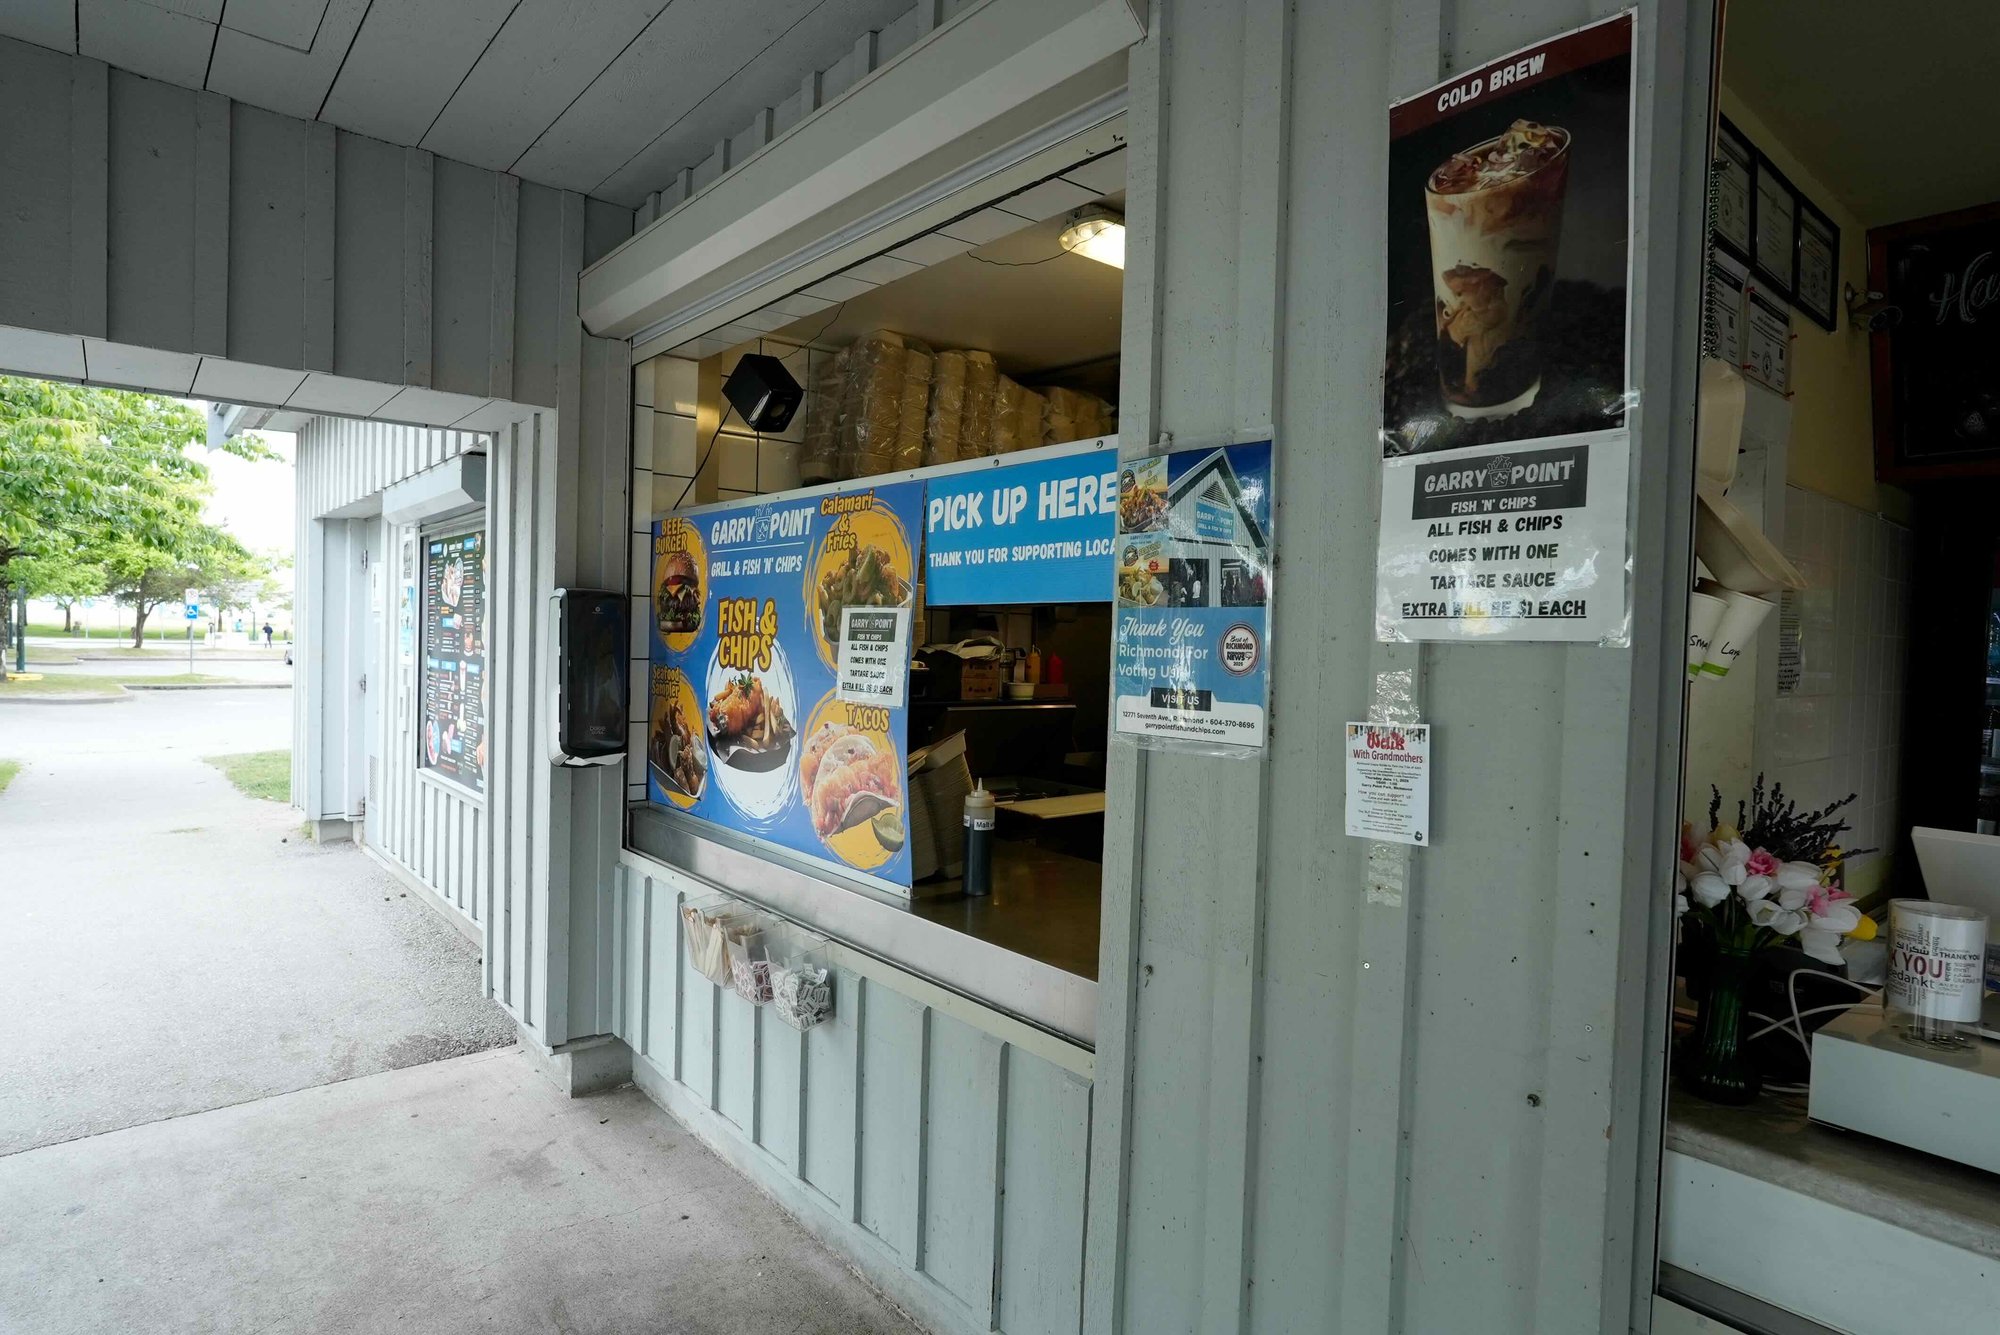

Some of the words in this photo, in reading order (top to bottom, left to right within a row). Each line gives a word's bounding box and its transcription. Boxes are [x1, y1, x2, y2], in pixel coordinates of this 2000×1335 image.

[1438, 78, 1483, 112] COLD
[1490, 53, 1546, 92] BREW
[1424, 469, 1488, 493] GARRY
[1511, 460, 1575, 485] POINT
[820, 488, 874, 516] Calamari
[928, 492, 984, 533] PICK
[992, 486, 1028, 526] UP
[1038, 472, 1118, 521] HERE
[1451, 501, 1477, 514] FISH
[1482, 499, 1495, 511] 'N'
[1499, 496, 1537, 510] CHIPS
[662, 518, 683, 536] BEEF
[711, 516, 756, 546] GARRY
[769, 507, 816, 540] POINT
[838, 513, 850, 533] &
[1428, 523, 1453, 537] ALL
[1459, 520, 1491, 535] FISH
[1497, 519, 1508, 532] &
[1515, 515, 1563, 532] CHIPS
[656, 532, 688, 555] BURGER
[826, 531, 856, 553] Fries
[930, 551, 962, 568] THANK
[964, 549, 984, 564] YOU
[988, 548, 1008, 563] FOR
[1012, 540, 1082, 562] SUPPORTING
[1429, 548, 1477, 563] COMES
[1482, 545, 1520, 560] WITH
[1526, 543, 1559, 559] ONE
[711, 562, 732, 578] GRILL
[734, 562, 740, 576] &
[742, 559, 760, 576] FISH
[764, 558, 774, 574] 'N'
[776, 555, 802, 572] CHIPS
[1431, 574, 1496, 590] TARTARE
[1502, 572, 1556, 588] SAUCE
[718, 597, 758, 636] FISH
[760, 598, 778, 636] &
[1402, 602, 1447, 616] EXTRA
[1518, 600, 1533, 618] $1
[1538, 600, 1586, 616] EACH
[851, 618, 868, 628] GARRY
[874, 618, 893, 629] POINT
[1120, 616, 1167, 638] Thank
[1169, 617, 1204, 645] You
[718, 634, 774, 672] CHIPS
[875, 644, 888, 652] CHIPS
[1120, 644, 1180, 658] Richmond
[1188, 646, 1208, 660] For
[865, 657, 876, 665] WITH
[652, 663, 680, 681] Seafood
[1118, 664, 1156, 680] Voting
[652, 680, 680, 700] Sampler
[1162, 694, 1184, 704] VISIT
[1187, 696, 1200, 705] US
[846, 704, 890, 733] TACOS
[1137, 712, 1157, 720] Seventh
[1210, 718, 1255, 729] 604-370-8696
[1353, 749, 1370, 759] With
[1372, 751, 1423, 763] Grandmothers
[1902, 952, 1943, 978] YOU
[1940, 952, 1967, 960] THANK
